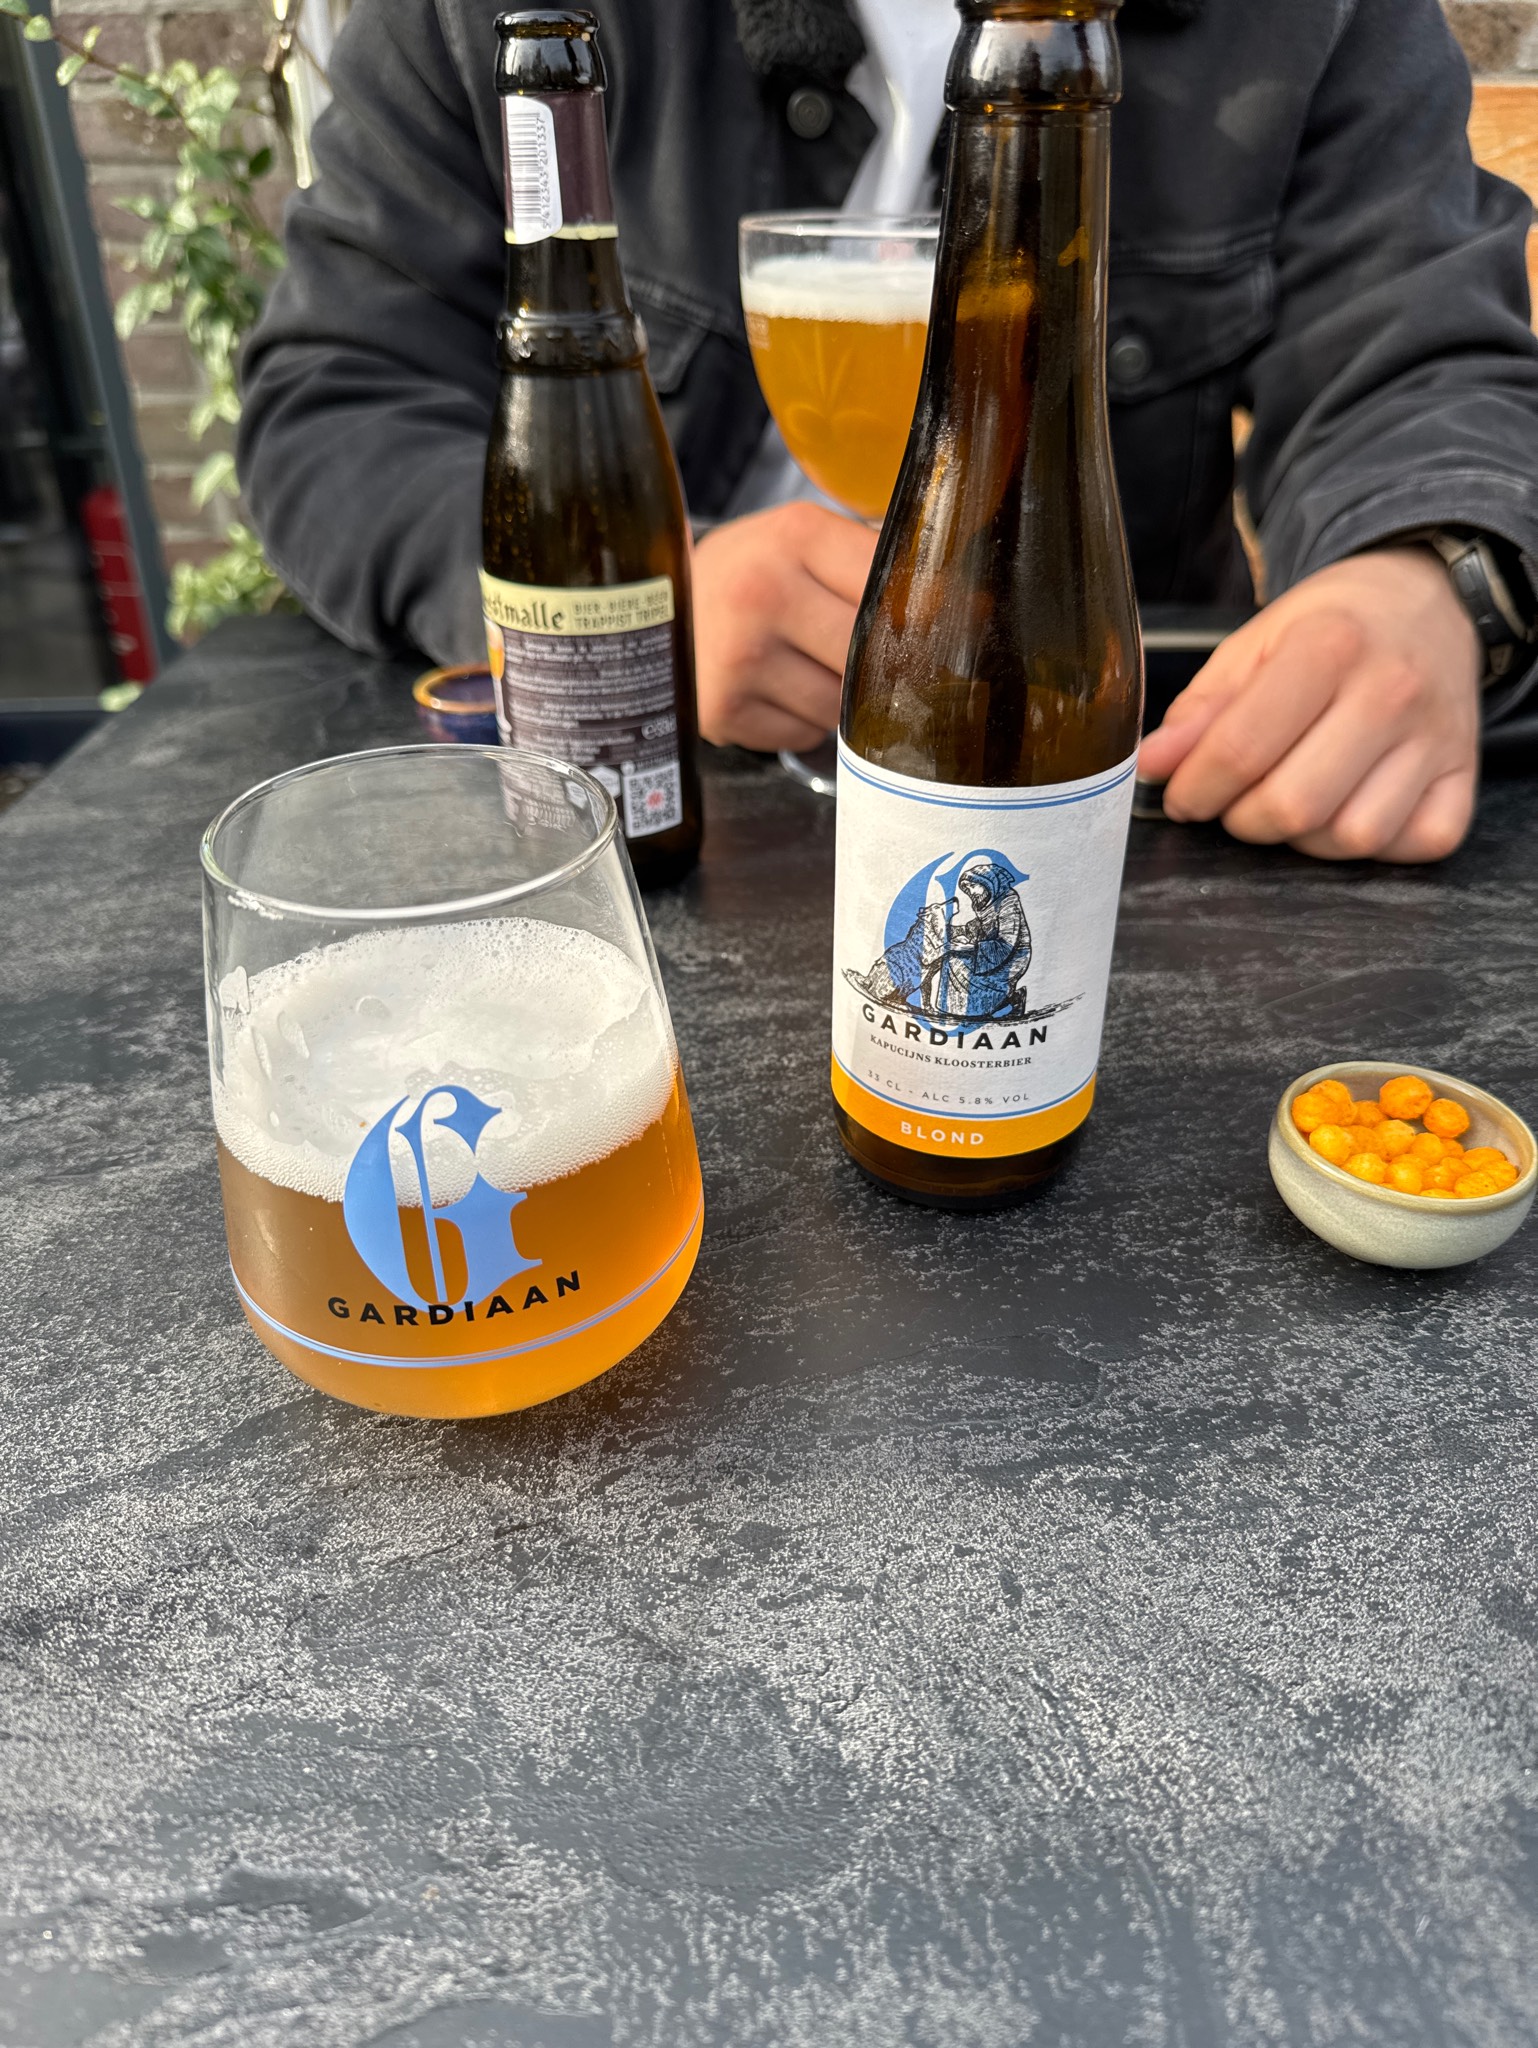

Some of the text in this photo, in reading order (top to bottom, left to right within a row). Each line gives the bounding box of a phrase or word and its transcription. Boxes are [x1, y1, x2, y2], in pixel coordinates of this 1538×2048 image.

[862, 1003, 1048, 1050] GARDIAAN
[870, 1034, 1032, 1069] KAPUCIJNS KLOOSTERBIER
[867, 1069, 880, 1082] 33
[886, 1079, 901, 1092] CL
[922, 1092, 950, 1103] ALC
[959, 1096, 993, 1105] 5.8%
[1002, 1093, 1030, 1103] VOL
[900, 1121, 985, 1146] BLOND
[328, 1270, 581, 1326] GARDIAAN
